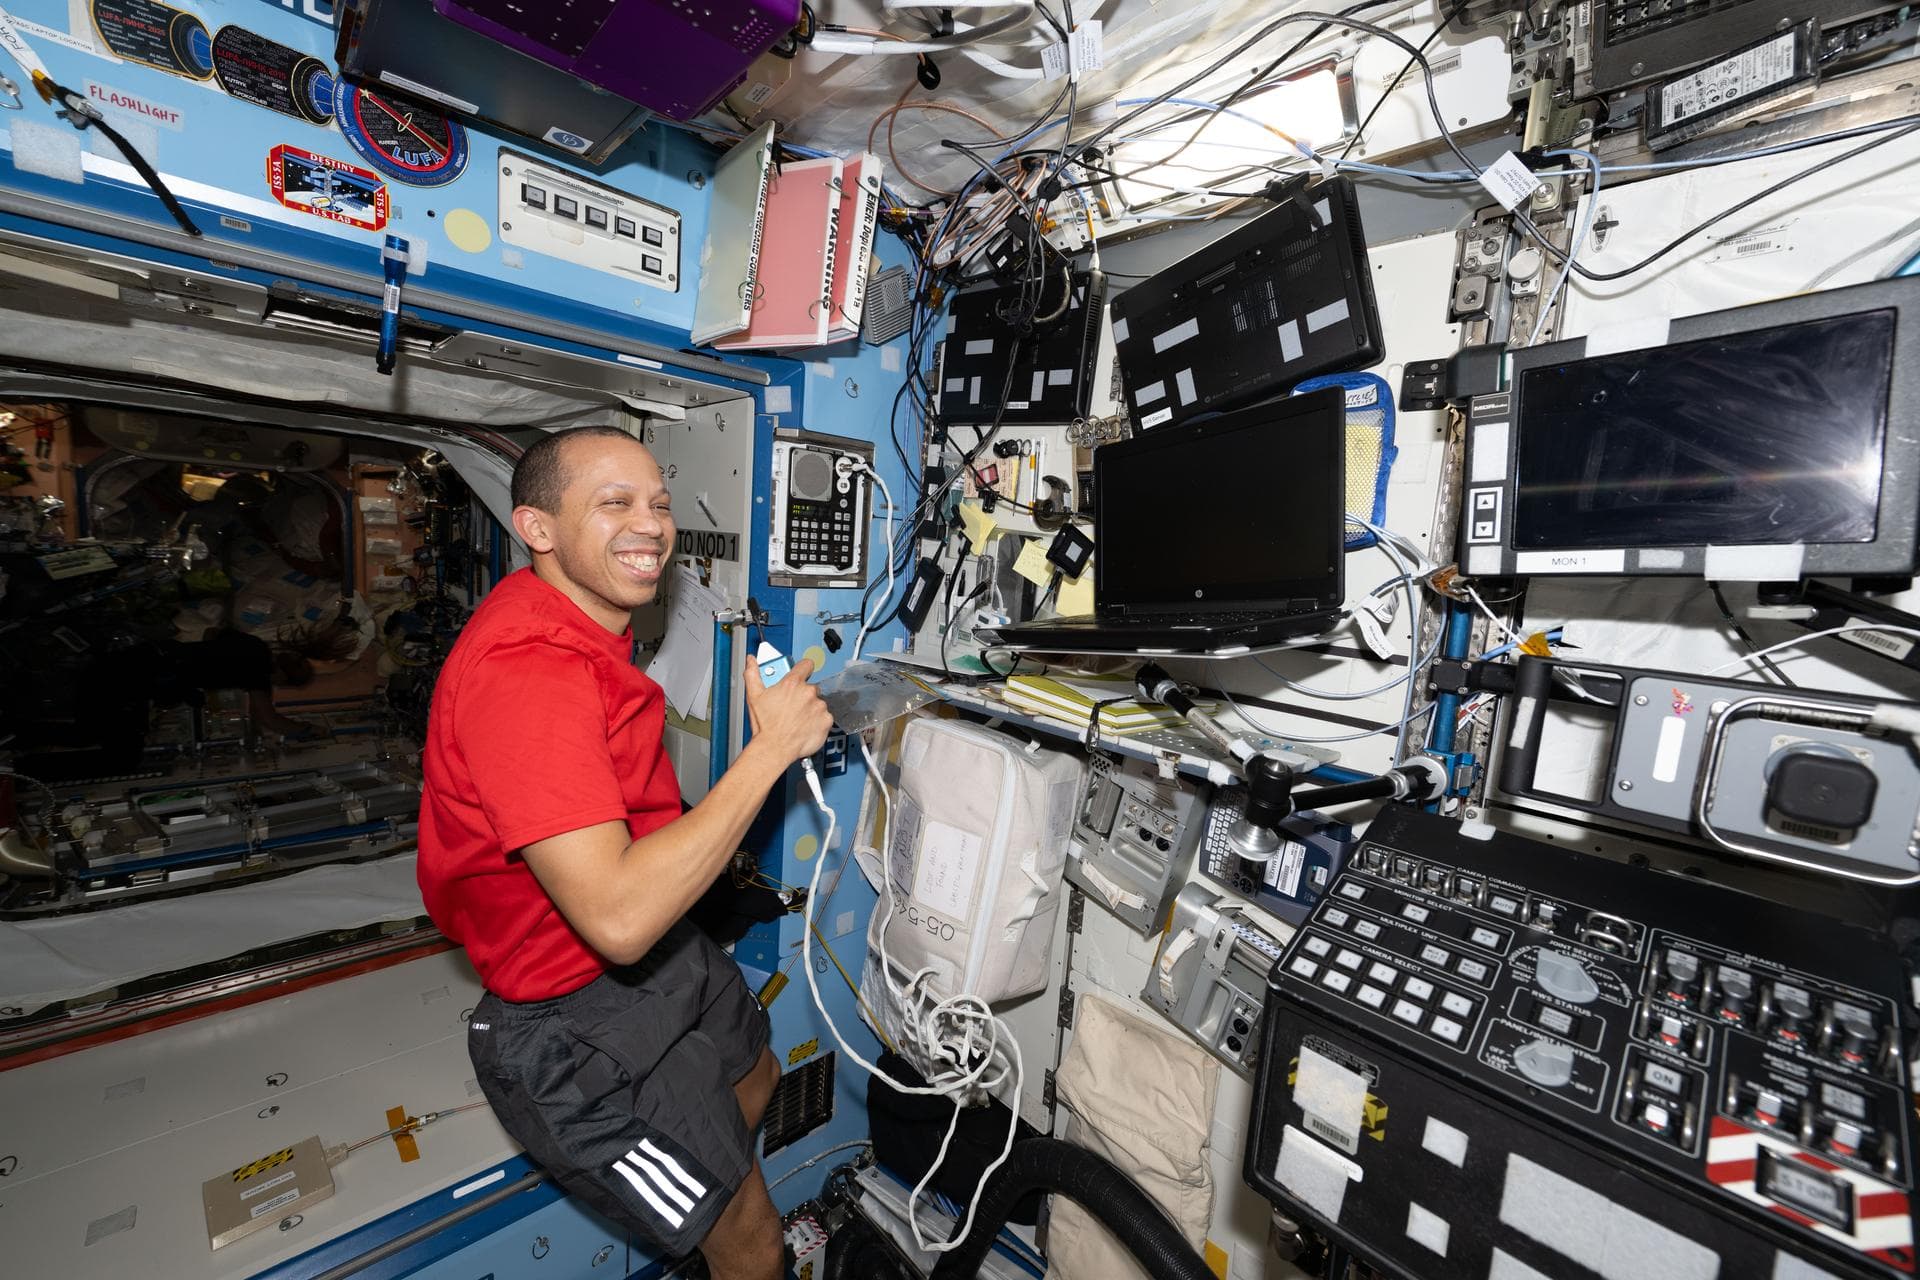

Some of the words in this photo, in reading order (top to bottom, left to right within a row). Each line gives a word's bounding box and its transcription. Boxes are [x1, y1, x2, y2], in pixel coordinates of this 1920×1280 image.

[89, 84, 180, 125] FLASHLIGHT
[309, 153, 355, 173] DESTINY
[392, 145, 444, 167] LUFA
[757, 160, 771, 208] PORTABLE
[312, 207, 329, 217] U.S.
[332, 213, 352, 224] LAB
[862, 191, 879, 225] EMER:
[752, 209, 766, 253] ONBOARD
[857, 222, 875, 265] Depress
[822, 206, 841, 311] WARNING
[742, 255, 759, 312] COMPUTERS
[677, 535, 694, 556] TO
[697, 536, 726, 560] NOD
[729, 538, 736, 560] 1
[1551, 555, 1579, 567] MON
[1456, 867, 1487, 880] CAMERA
[1488, 876, 1527, 892] COMMAND
[1393, 888, 1425, 902] MONITOR
[1426, 899, 1453, 911] SELECT
[1495, 900, 1514, 911] AUTO
[1380, 916, 1418, 934] MULTIPLEX
[1420, 930, 1439, 942] UNIT
[1361, 945, 1393, 962] CAMERA
[1393, 958, 1423, 973] SELECT
[1549, 939, 1572, 951] JOINT
[1573, 945, 1606, 963] SELECT
[1744, 953, 1787, 971] BRAKES
[1592, 969, 1614, 981] PITCH
[1531, 989, 1552, 1002] RWS
[1554, 998, 1592, 1017] STATUS
[1651, 1003, 1678, 1018] AUTO
[1500, 1018, 1555, 1043] PANEL/INST
[1485, 1052, 1510, 1064] LAMP
[1487, 1058, 1508, 1071] TEST
[1649, 1049, 1686, 1068] SAFING
[1766, 1040, 1795, 1054] HOT
[1795, 1050, 1854, 1075] BACKUP
[1652, 1070, 1674, 1085] ON
[1641, 1090, 1667, 1105] SAFE
[1781, 1173, 1837, 1200] STOP
